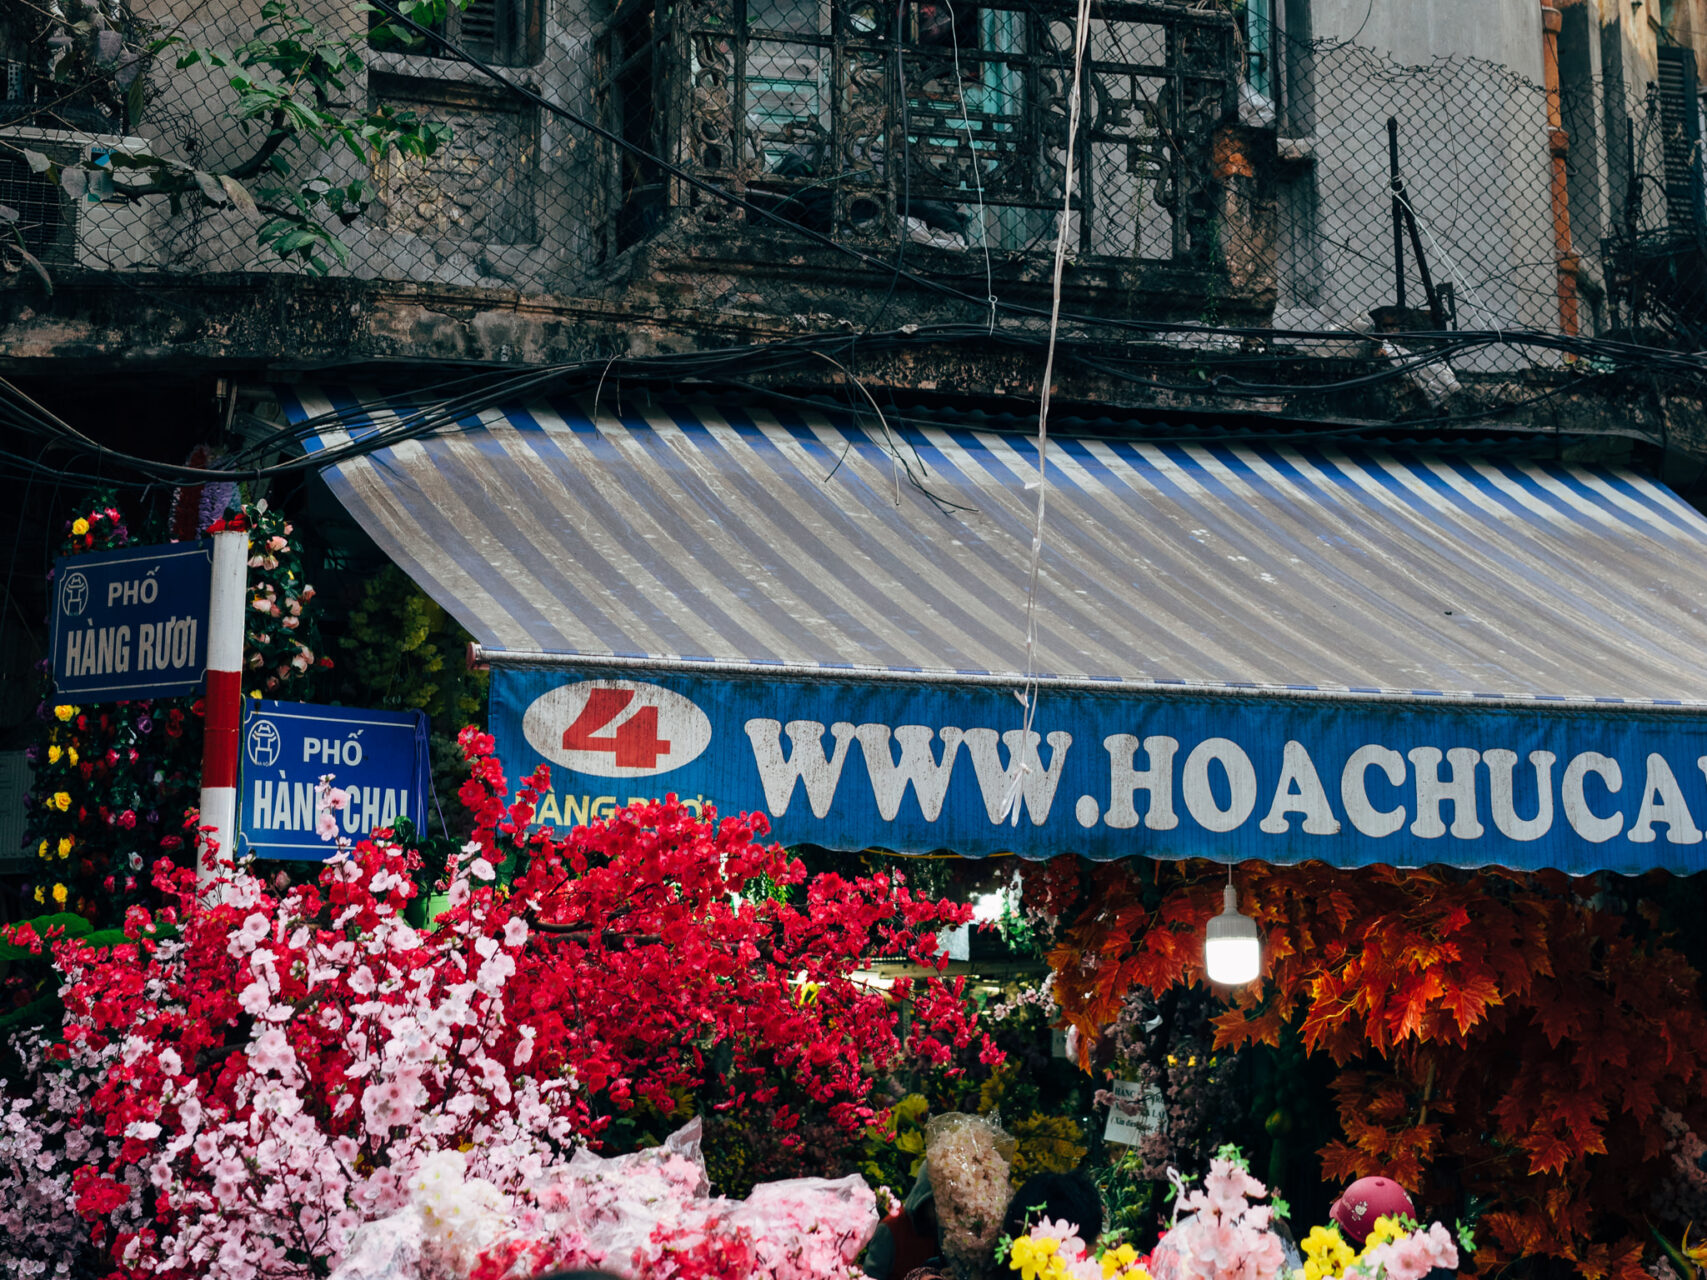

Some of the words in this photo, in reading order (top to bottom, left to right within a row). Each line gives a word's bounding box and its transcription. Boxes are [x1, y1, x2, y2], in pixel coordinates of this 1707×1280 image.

[107, 566, 160, 607] PHỐ
[65, 618, 131, 677] HÀNG
[138, 616, 197, 671] RƯƠI
[303, 729, 364, 766] PHỐ
[562, 688, 671, 769] 4
[253, 770, 334, 833] HÀN
